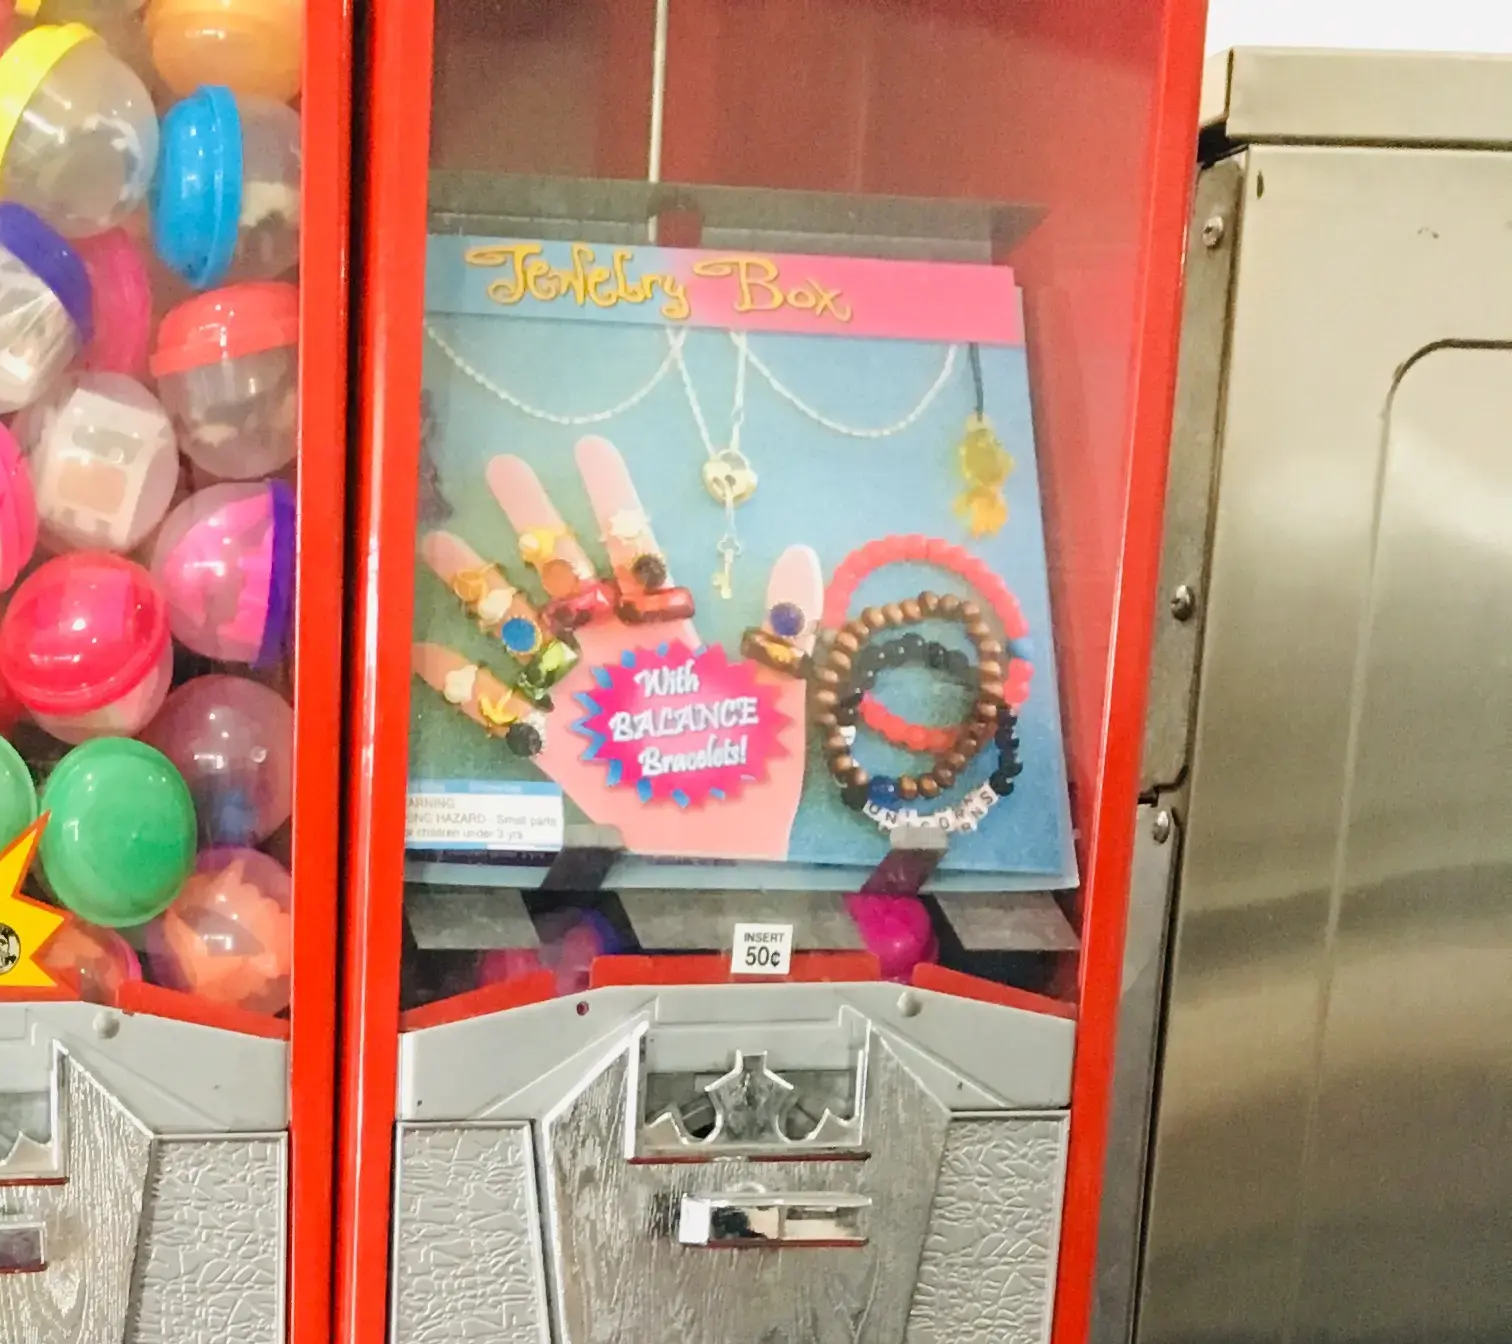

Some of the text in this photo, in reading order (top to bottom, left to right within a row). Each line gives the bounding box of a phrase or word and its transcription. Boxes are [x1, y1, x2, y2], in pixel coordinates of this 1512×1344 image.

[692, 256, 852, 321] Box
[633, 659, 700, 697] With
[609, 696, 759, 742] BALANCE
[744, 932, 785, 943] INSERT
[745, 946, 781, 967] 50¢
